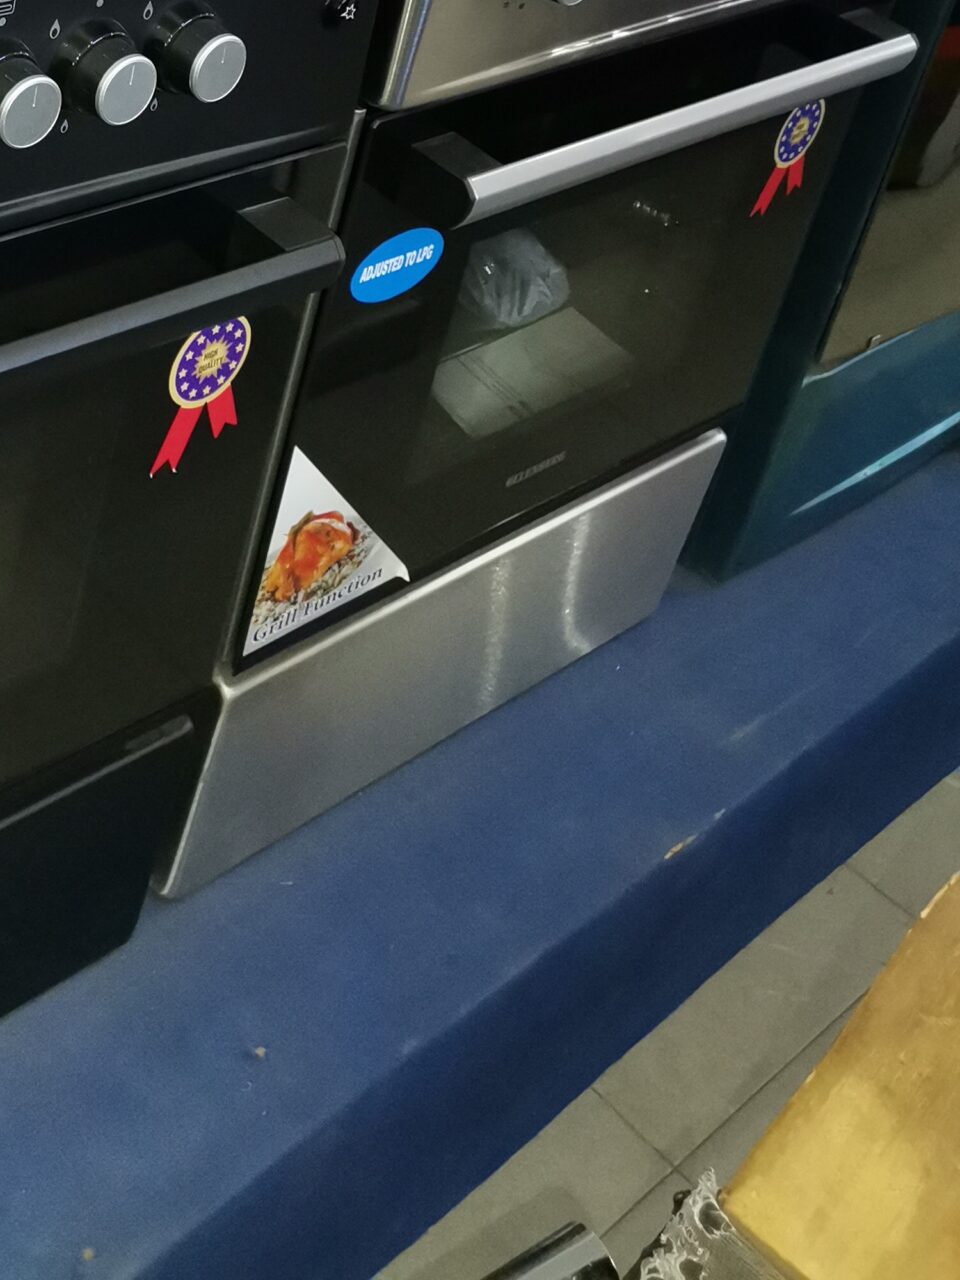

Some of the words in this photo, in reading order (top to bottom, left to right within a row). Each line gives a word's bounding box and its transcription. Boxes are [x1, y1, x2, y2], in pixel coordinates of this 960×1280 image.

[359, 254, 405, 284] ADJUSTED
[404, 250, 417, 268] TO
[416, 243, 435, 263] LPG
[252, 607, 298, 643] Grill
[303, 567, 383, 616] Function
